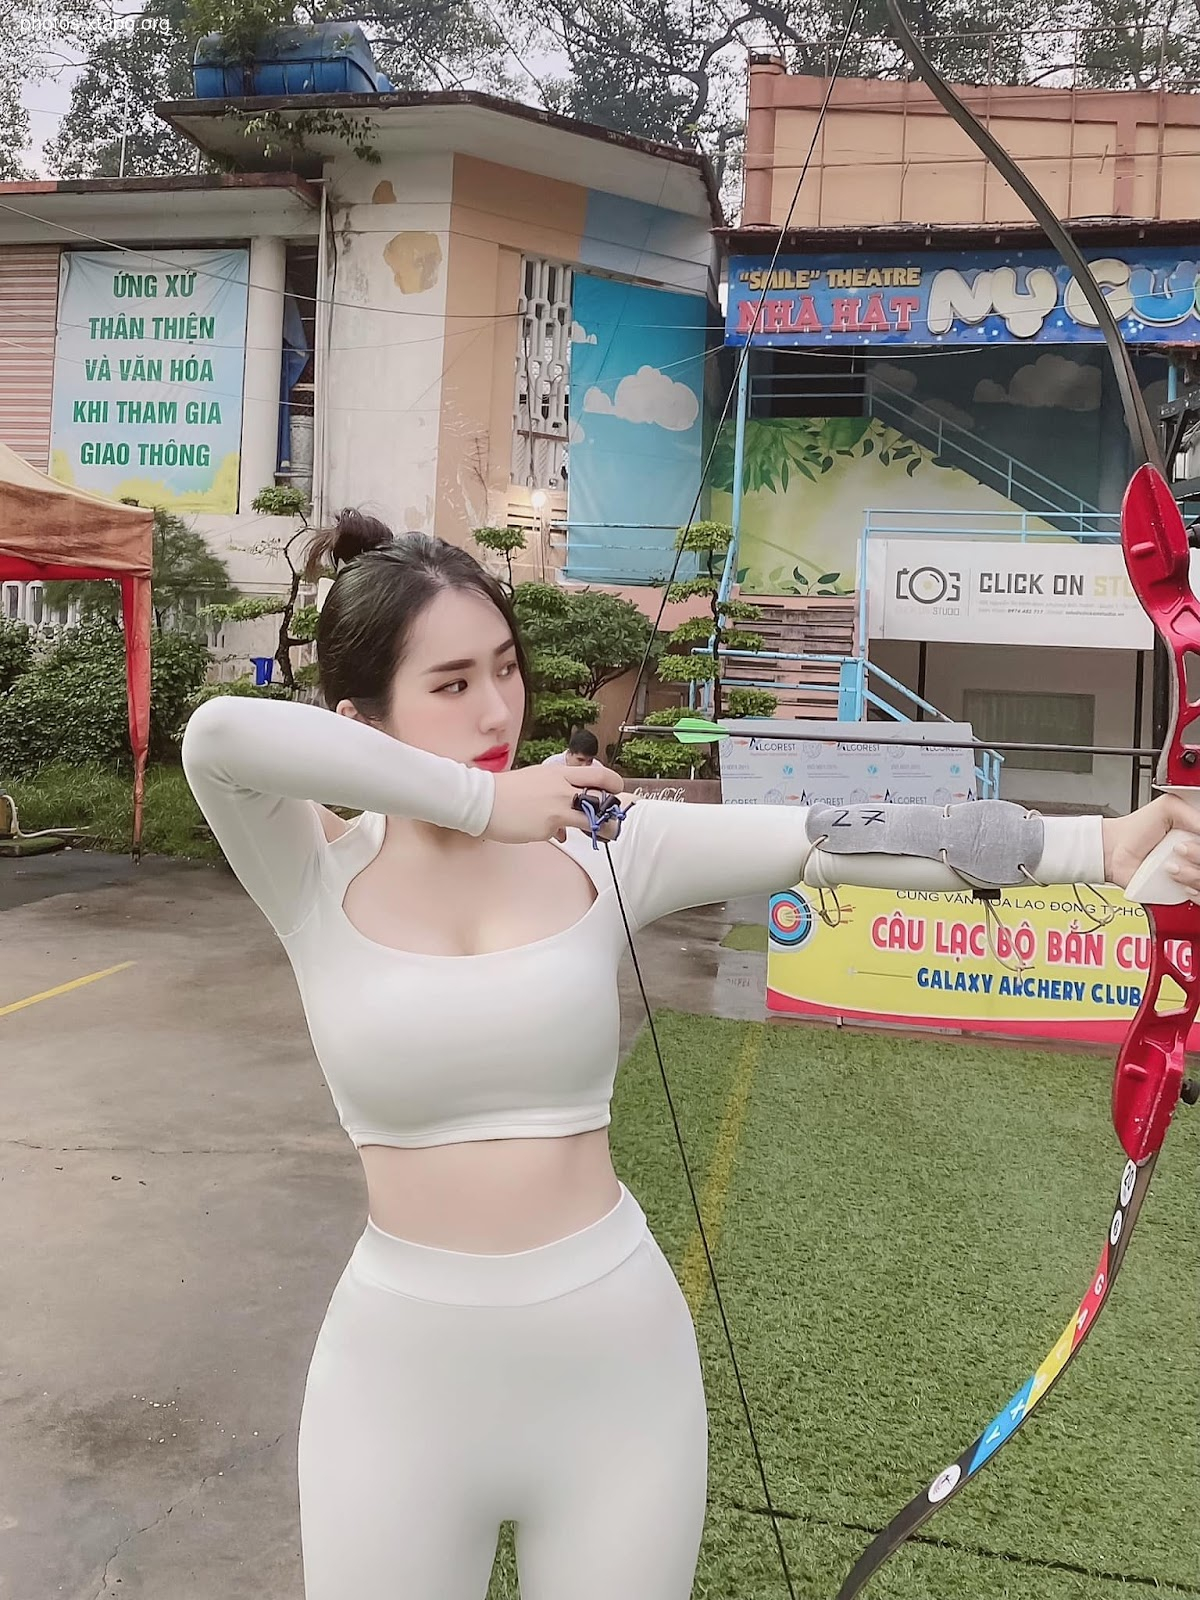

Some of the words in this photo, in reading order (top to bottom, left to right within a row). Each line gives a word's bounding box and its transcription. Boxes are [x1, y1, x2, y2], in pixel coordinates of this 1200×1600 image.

[113, 270, 158, 298] ỨNG
[826, 267, 921, 288] THEATRE
[89, 313, 145, 339] THÂN
[152, 312, 215, 344] THIỆN
[85, 354, 111, 381] VÀ
[119, 354, 162, 381] VĂN
[170, 354, 214, 382] HÓA
[73, 401, 108, 423] KHI
[116, 401, 177, 424] THAM
[185, 401, 222, 424] GIA
[80, 442, 130, 465] GIAO
[138, 439, 210, 466] THÔNG
[979, 572, 1044, 595] CLICK
[1053, 574, 1084, 596] ON
[1015, 898, 1046, 910] LAO
[872, 911, 925, 952] CÂU
[936, 922, 986, 962] LẠC
[1048, 919, 1103, 966] BẮN
[917, 967, 993, 994] GALAXY
[999, 975, 1086, 1002] ARCHERY
[1091, 983, 1142, 1007] CLUB
